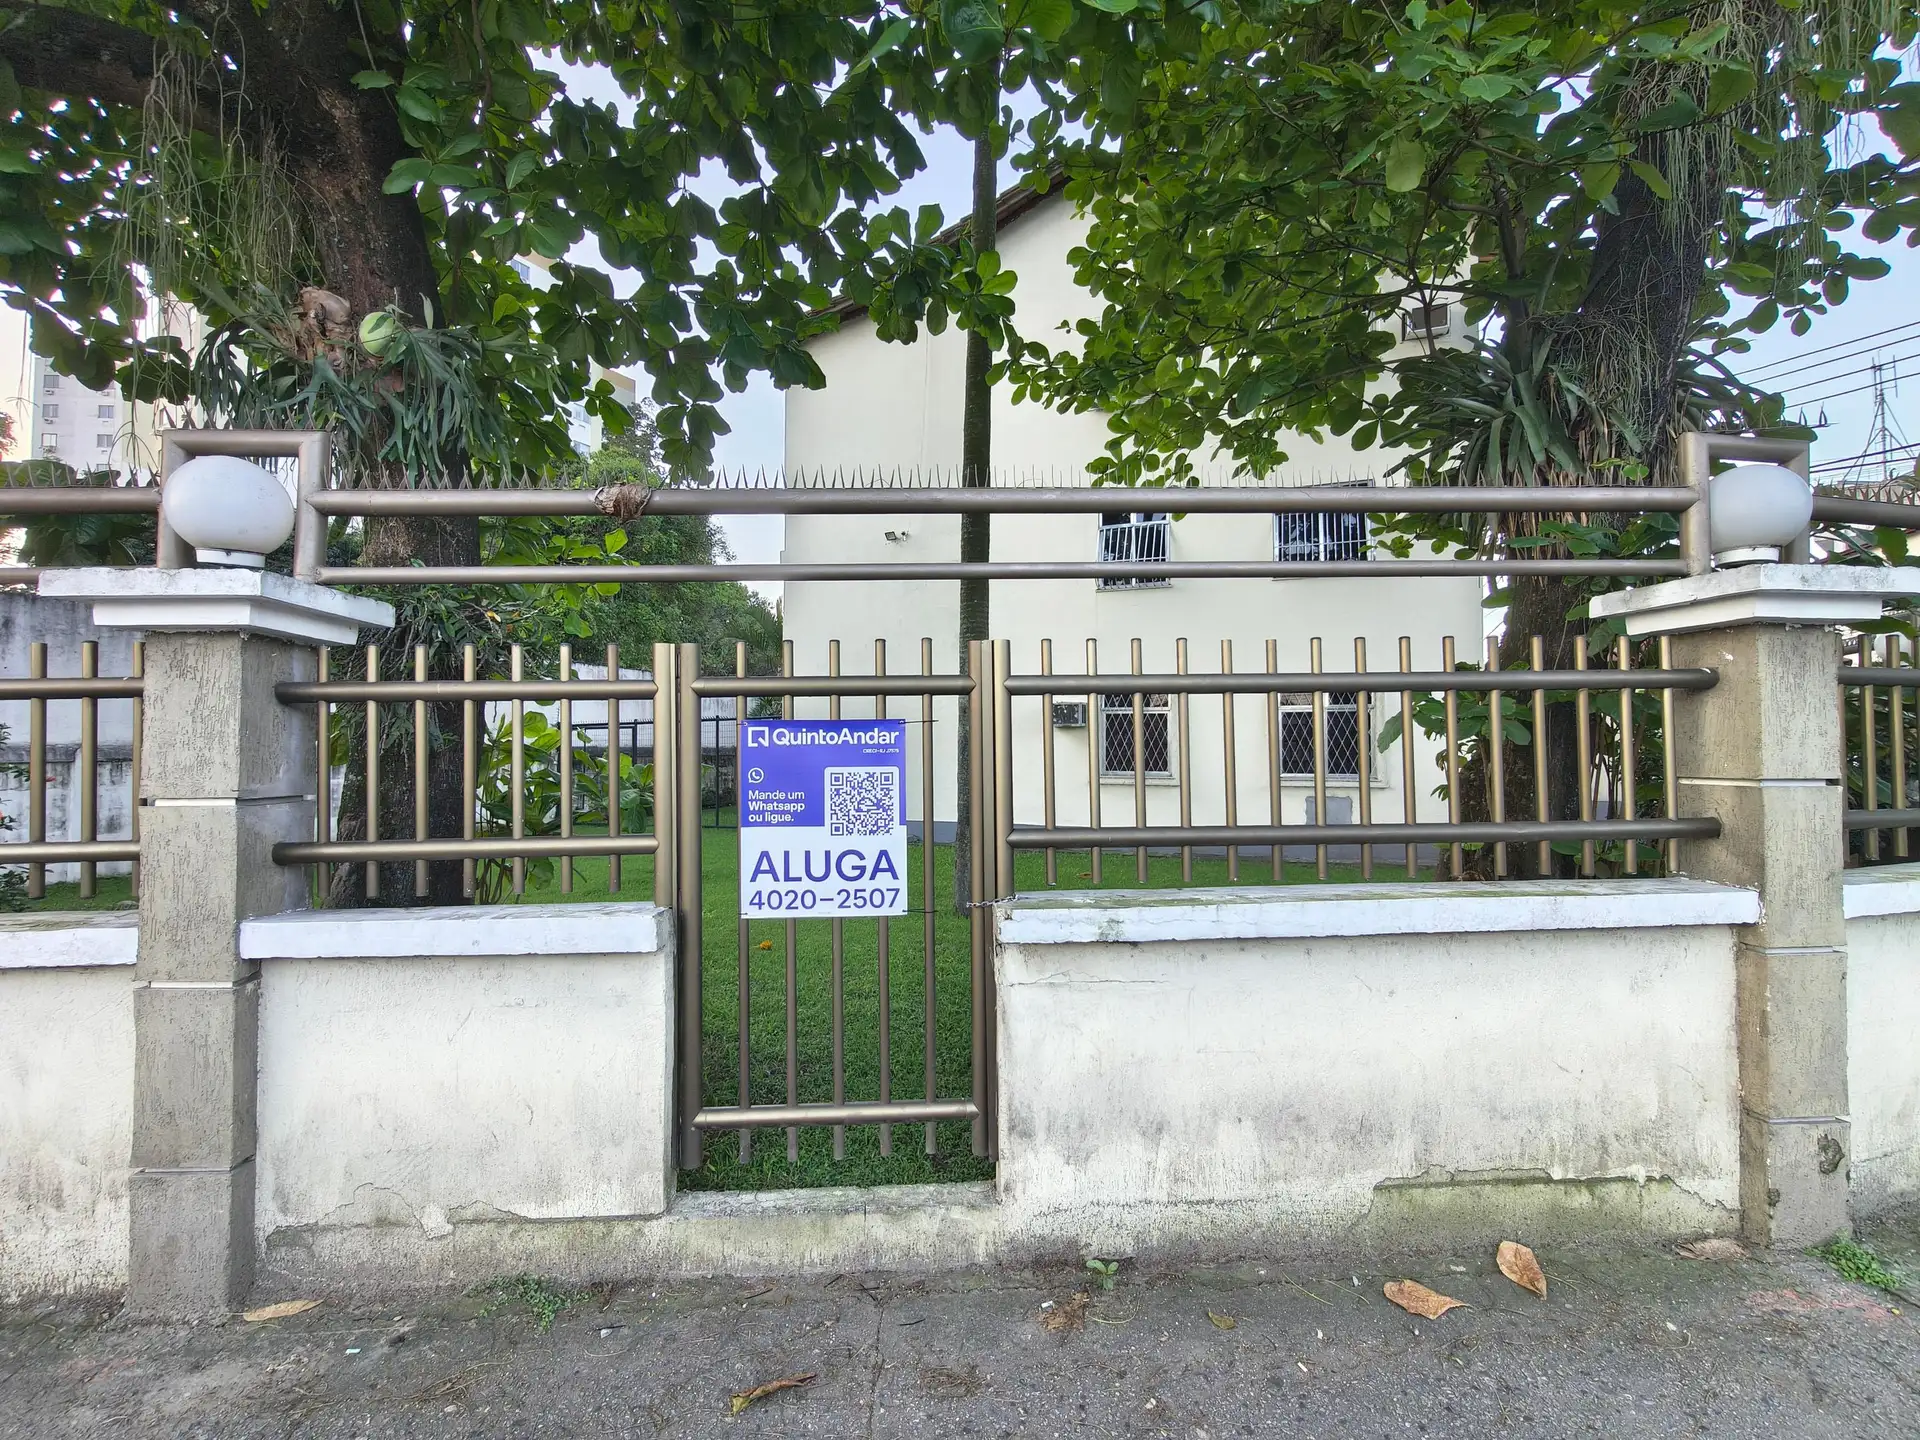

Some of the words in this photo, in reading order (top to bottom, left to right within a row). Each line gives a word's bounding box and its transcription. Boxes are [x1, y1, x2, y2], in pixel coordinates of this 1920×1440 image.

[772, 727, 900, 747] QuintoAndar
[748, 789, 786, 800] Mande
[787, 791, 805, 800] um
[748, 801, 805, 813] Whatsapp
[748, 814, 763, 822] ou
[765, 811, 794, 824] ligue.
[749, 849, 900, 883] ALUGA
[749, 887, 900, 910] 4020-2507
